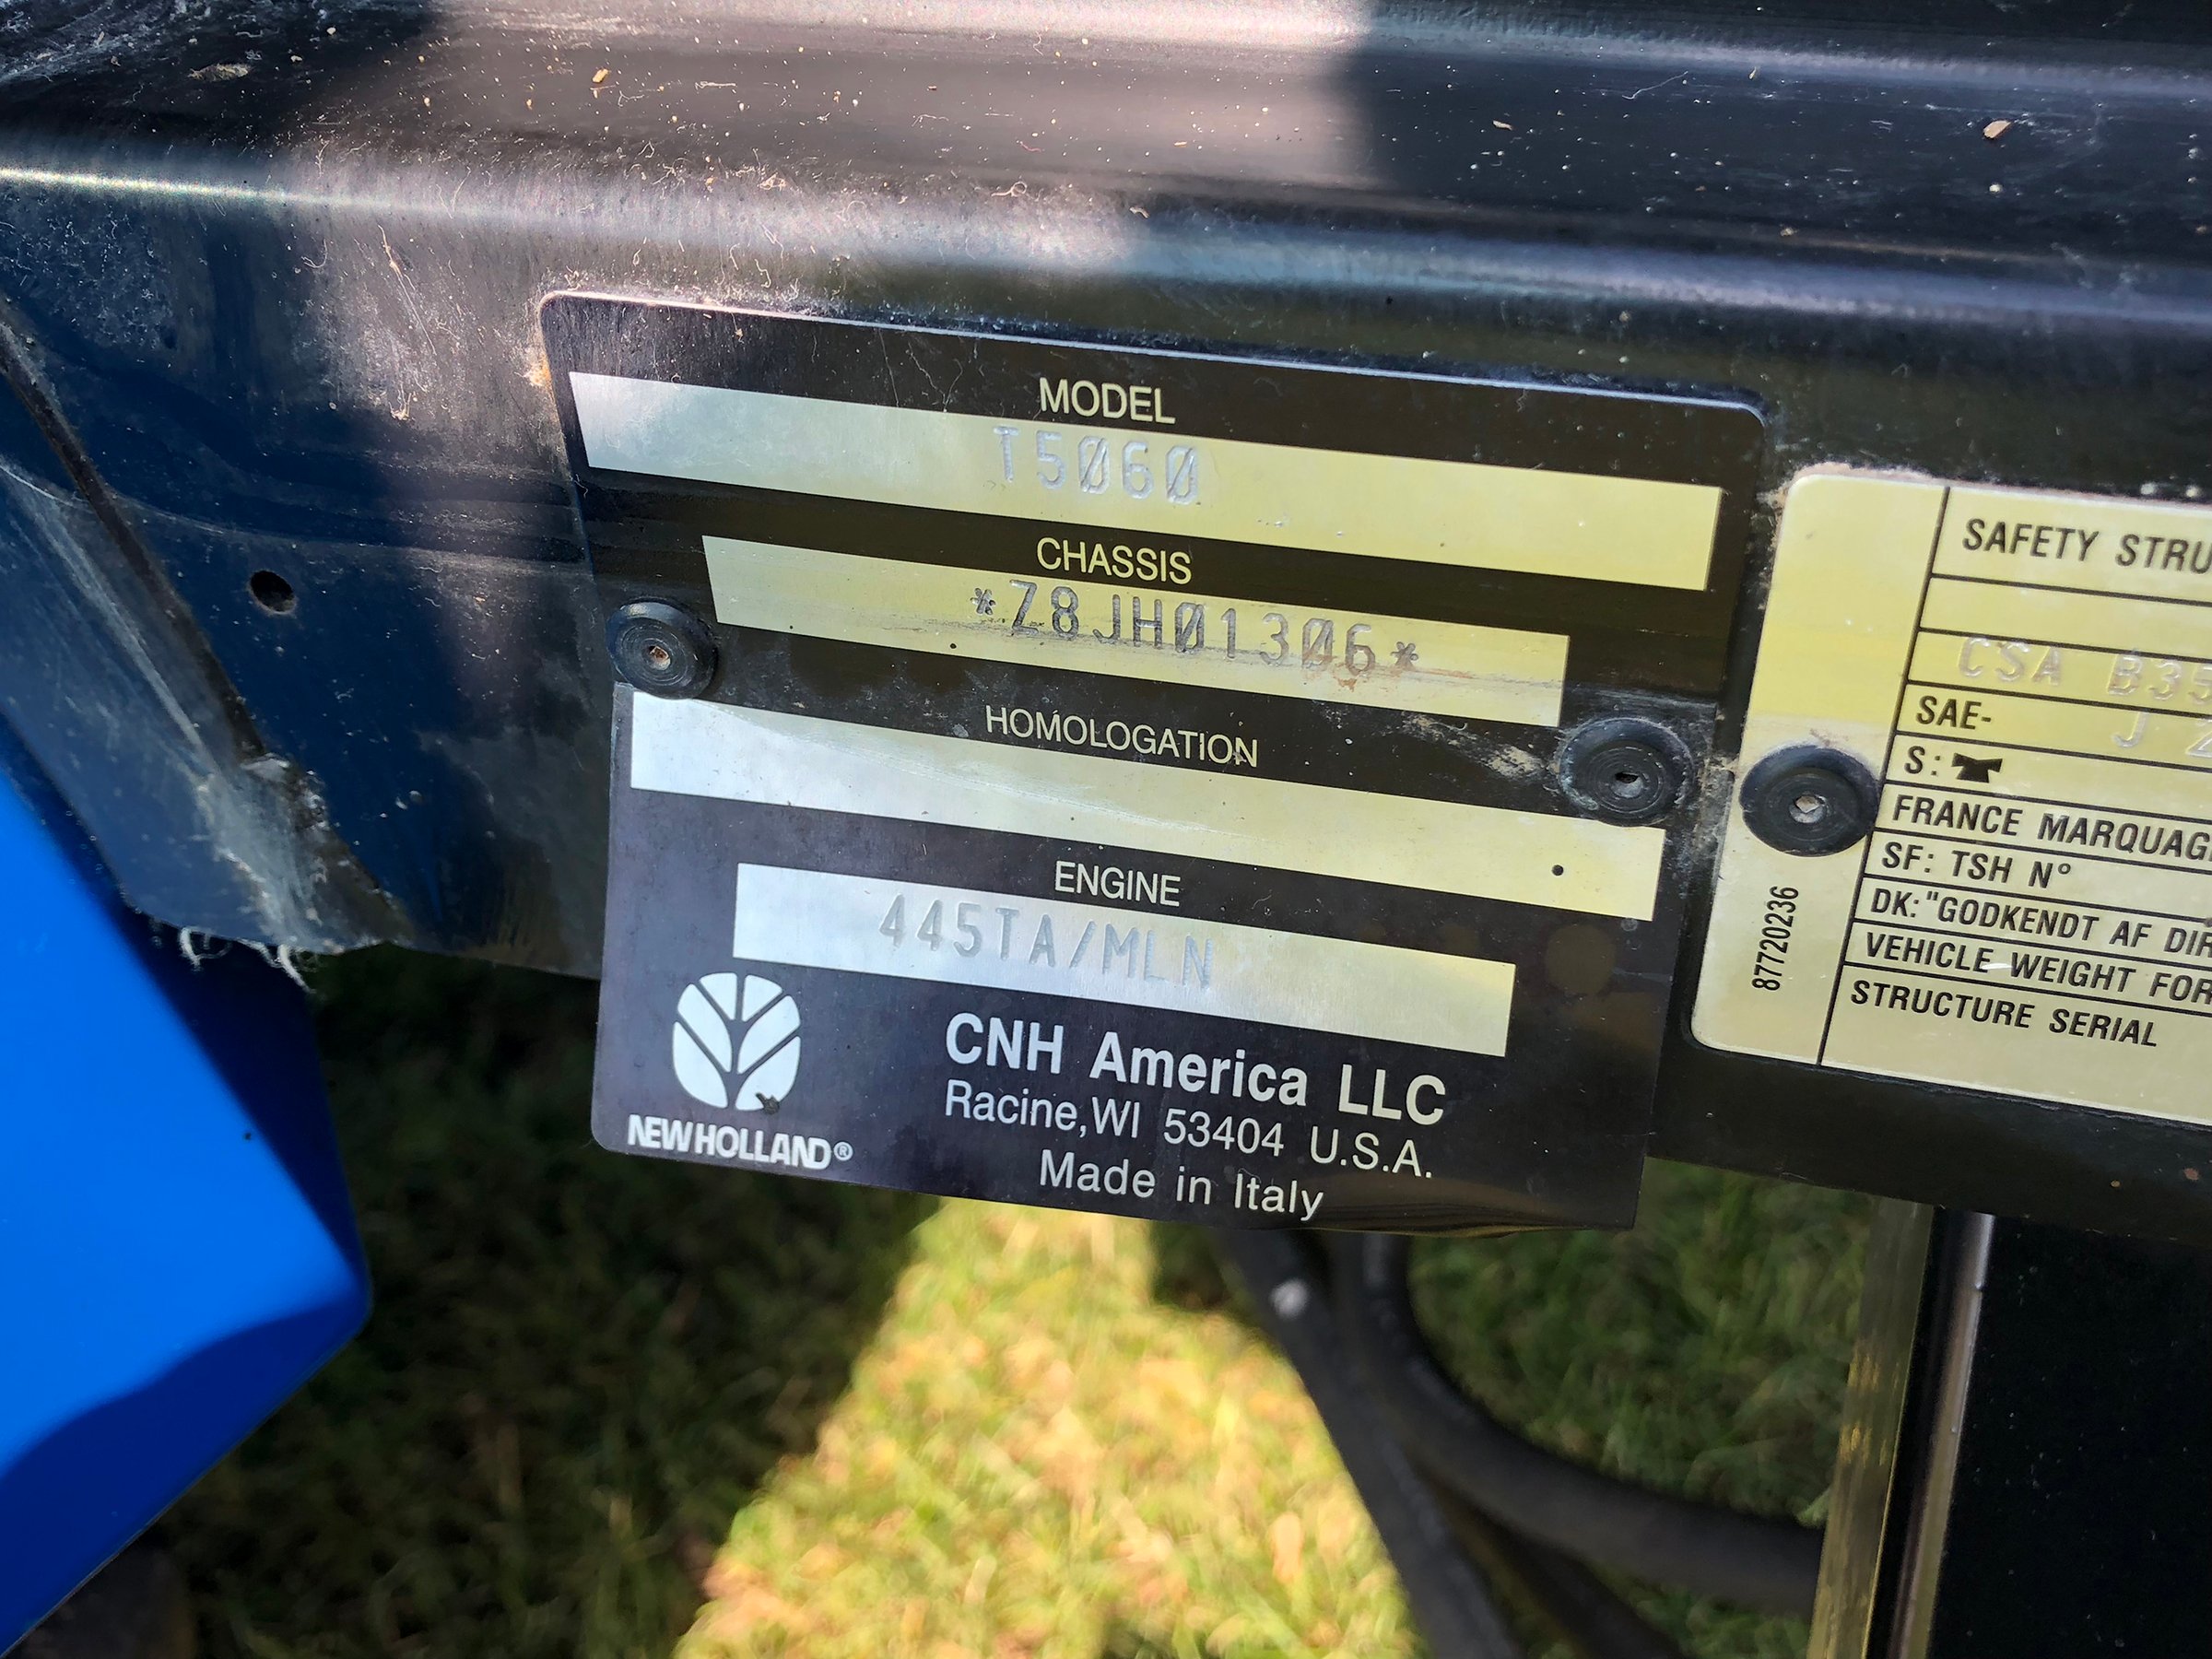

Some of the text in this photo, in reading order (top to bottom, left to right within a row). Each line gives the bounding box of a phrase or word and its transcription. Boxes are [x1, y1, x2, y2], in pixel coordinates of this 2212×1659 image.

[1039, 377, 1176, 424] MODEL
[993, 425, 1198, 505] T5060
[1037, 537, 1192, 585] CHASSIS
[1962, 518, 2099, 561] SAFETY
[1957, 637, 2063, 687] CSA
[985, 706, 1258, 767] HOMOLOGATION
[1915, 695, 1992, 730] SAE-
[1892, 794, 2212, 862] FRANCE MARQUAG
[1054, 860, 1182, 908] ENGINE
[1881, 841, 1935, 874] SF:
[1951, 850, 2013, 883] TSH
[879, 893, 1214, 990] 445TA/MLN
[1751, 886, 1798, 991] 87720236
[1865, 932, 1994, 973] VEHICLE
[2010, 951, 2136, 993] WEIGHT
[2109, 921, 2152, 947] AF
[1850, 980, 2158, 1047] STRUCTURE SERIAL
[946, 1012, 1446, 1125] CNH America LLC
[1163, 1108, 1284, 1157] 53404
[1310, 1125, 1431, 1179] U.S.A.
[1040, 1149, 1324, 1222] Made in Italy
